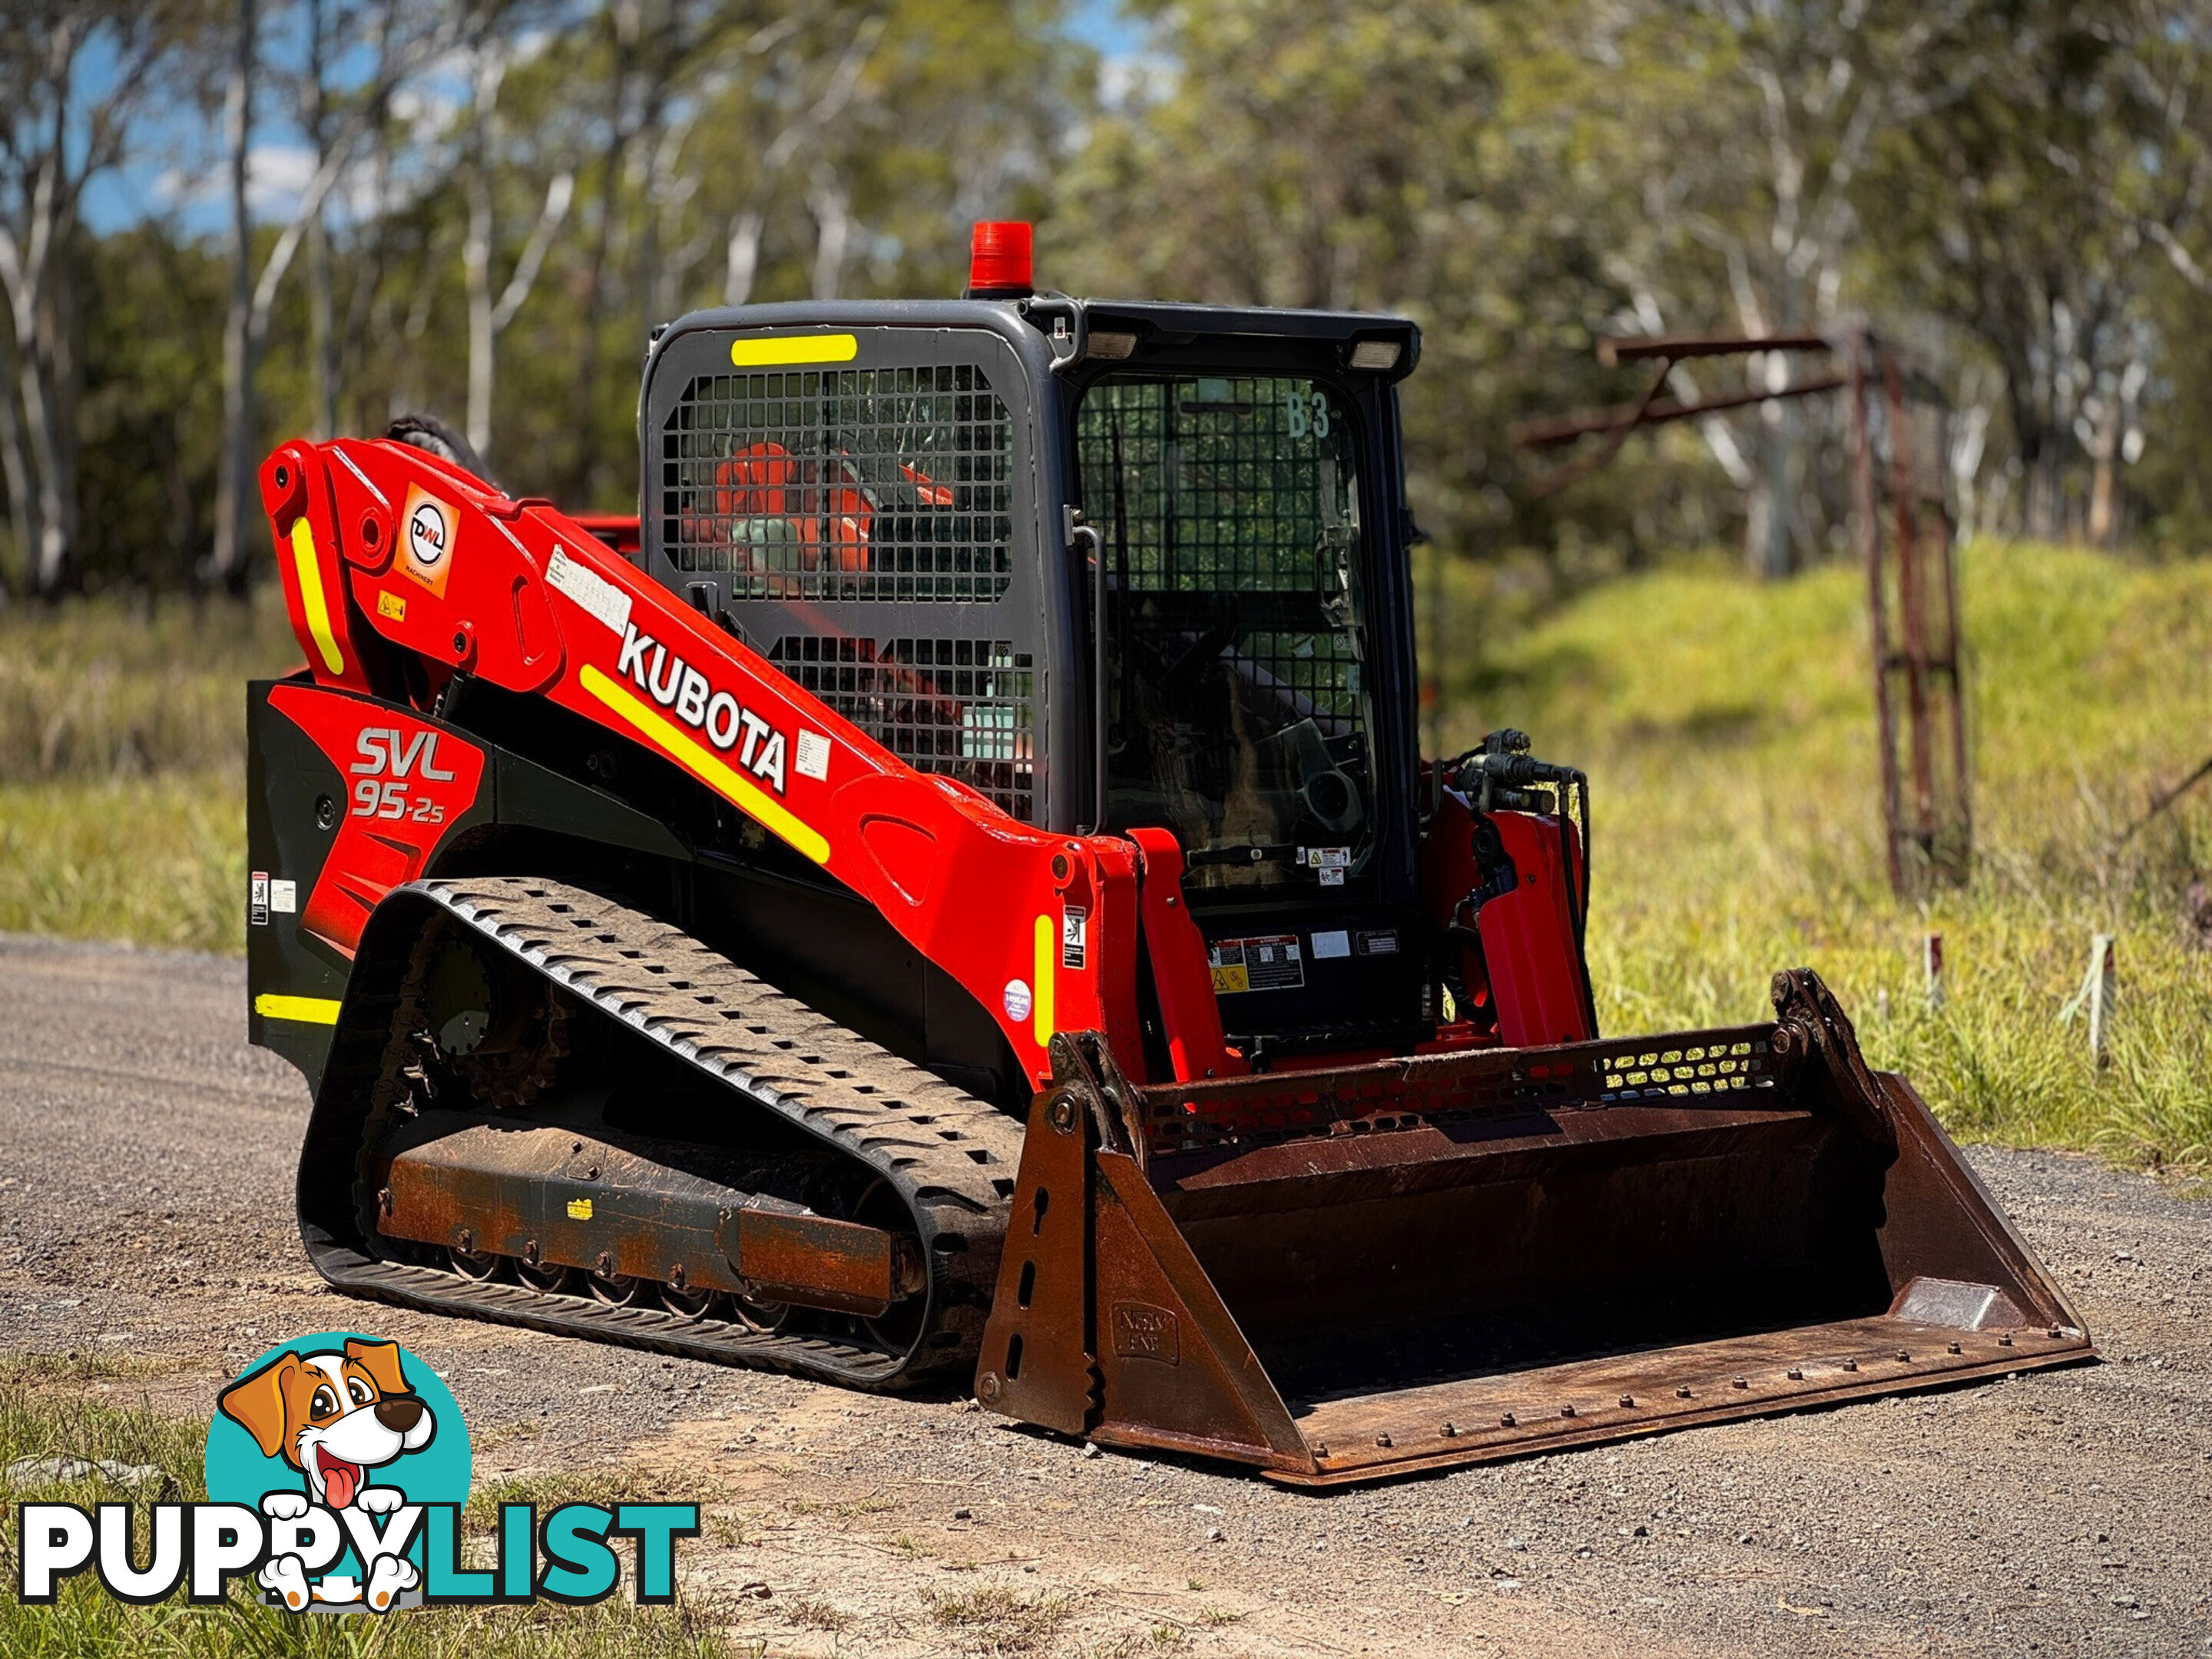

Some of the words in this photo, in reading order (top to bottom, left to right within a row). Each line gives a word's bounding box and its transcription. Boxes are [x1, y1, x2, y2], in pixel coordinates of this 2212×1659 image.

[411, 516, 445, 551] DWL
[405, 565, 434, 586] MACHINERY
[617, 621, 786, 794] KUBOTA
[349, 727, 456, 783] SVL
